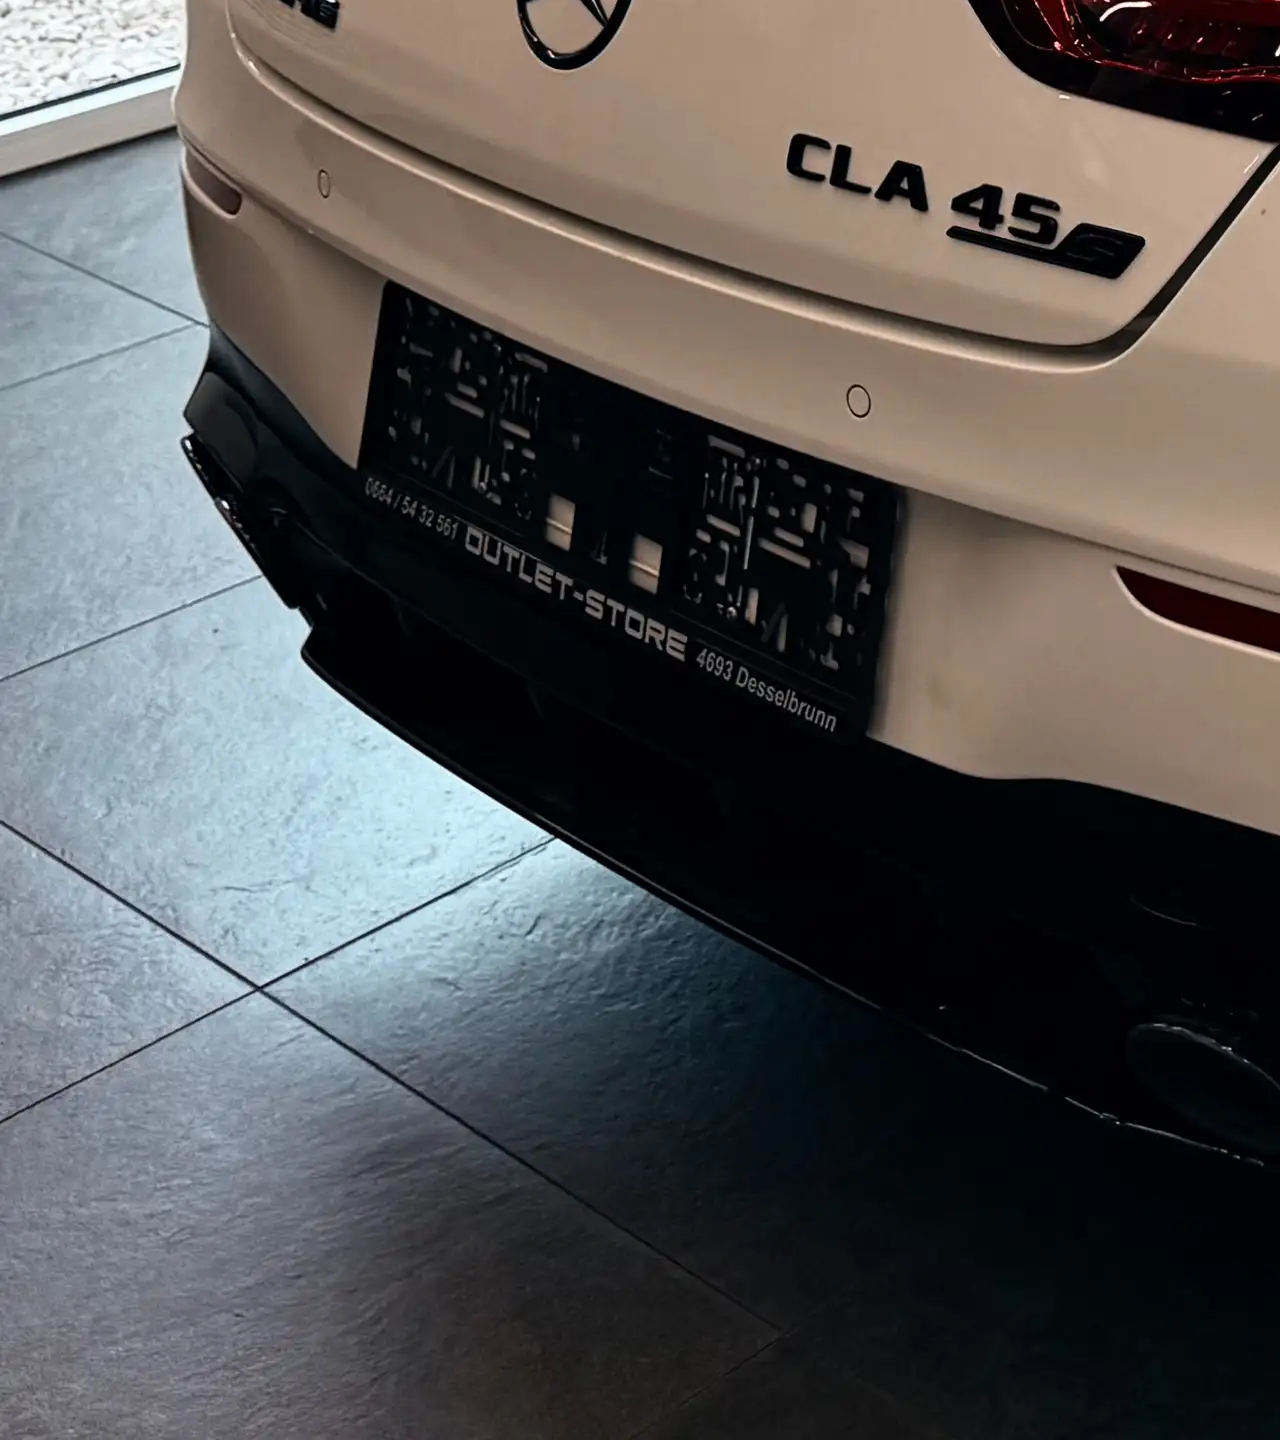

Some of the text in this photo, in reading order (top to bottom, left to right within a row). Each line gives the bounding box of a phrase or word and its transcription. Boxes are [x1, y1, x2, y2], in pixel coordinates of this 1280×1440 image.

[786, 133, 929, 212] CLA
[950, 183, 1061, 245] 45
[402, 495, 418, 518] 54
[419, 505, 434, 528] 32
[435, 513, 459, 539] 561
[464, 526, 688, 661] OUTLET-STORE
[696, 648, 733, 682] 4693
[735, 666, 838, 733] Desselbrunn
